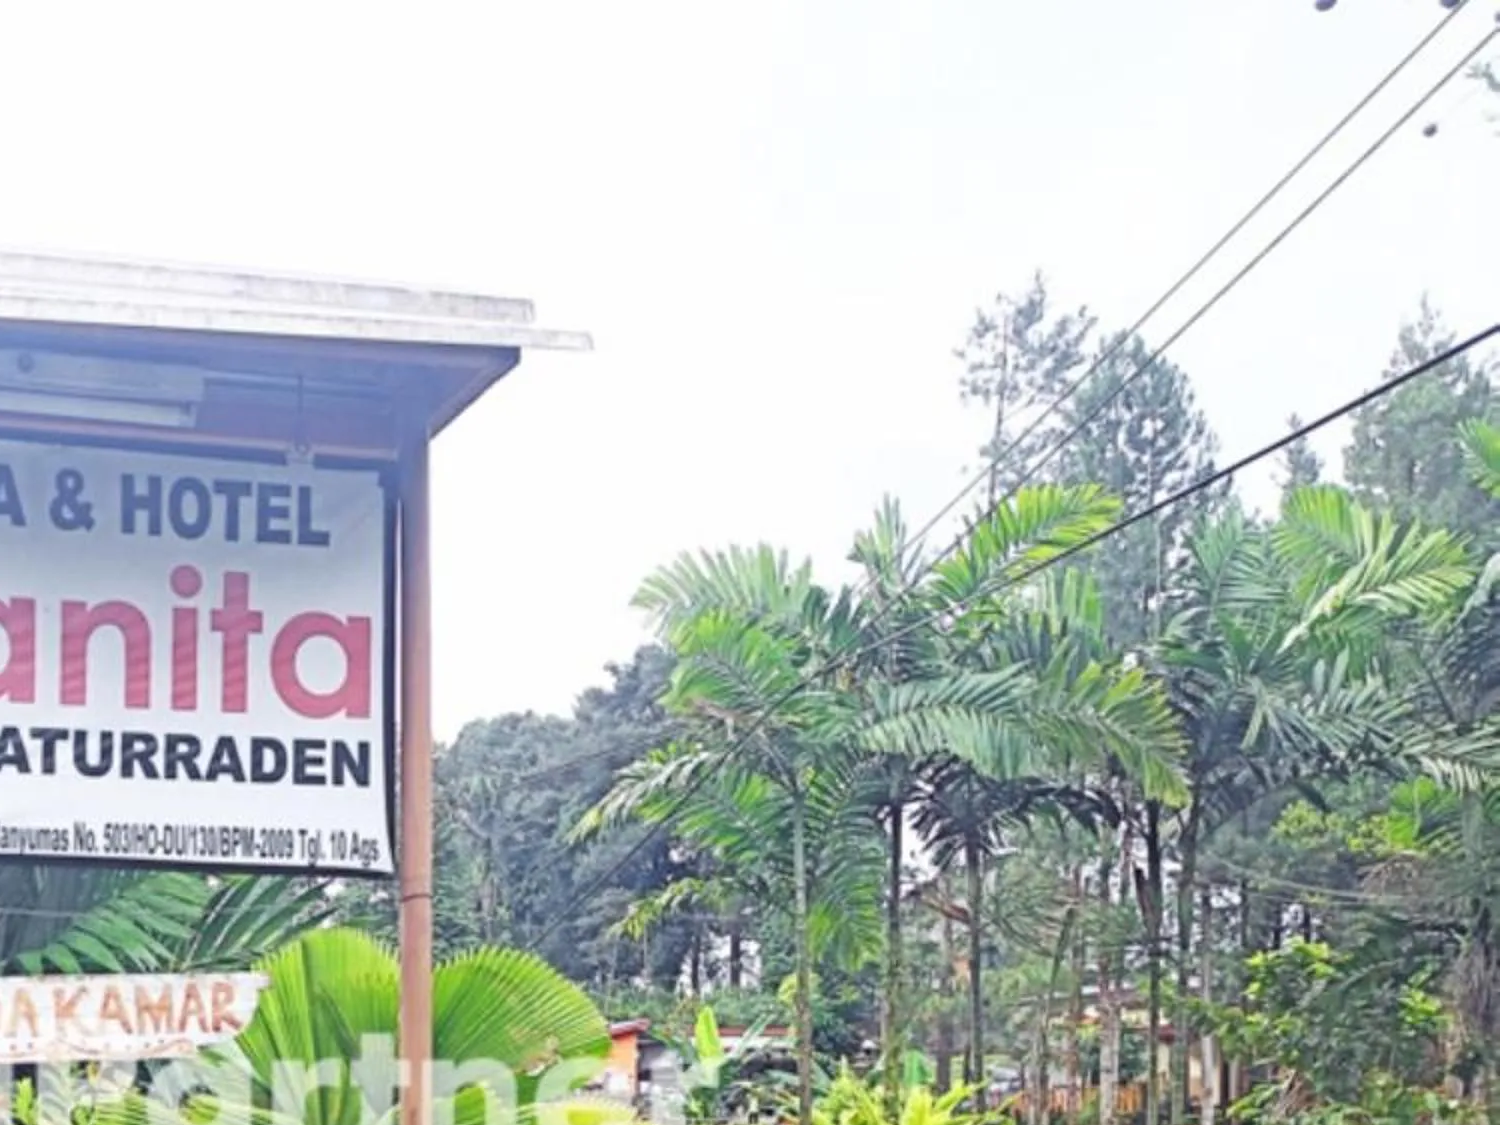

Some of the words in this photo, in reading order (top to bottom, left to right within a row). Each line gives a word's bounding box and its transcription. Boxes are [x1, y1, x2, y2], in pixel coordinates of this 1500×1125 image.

[49, 467, 95, 533] &
[120, 473, 331, 548] HOTEL
[73, 821, 99, 852] No.
[299, 828, 326, 867] Tgl.
[331, 829, 347, 861] 10
[350, 831, 380, 867] Ags
[53, 981, 243, 1035] KAMAR
